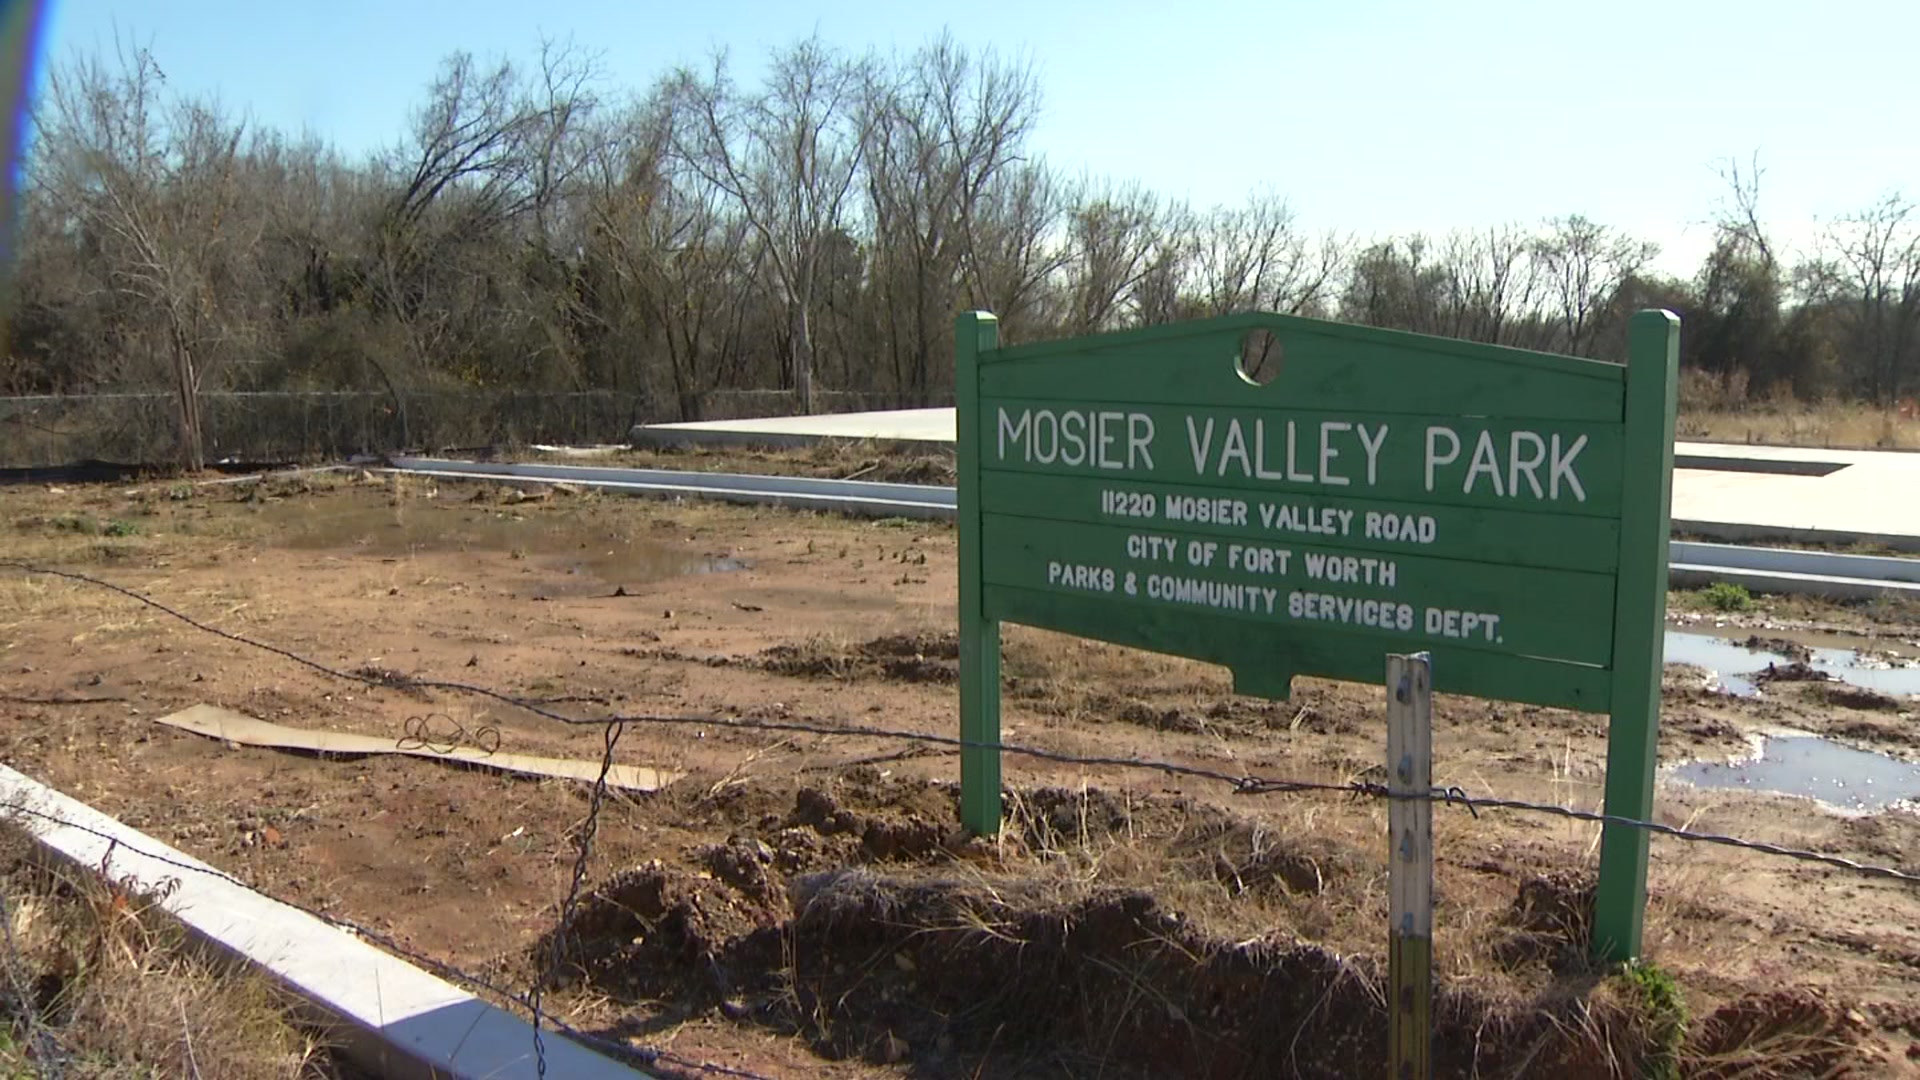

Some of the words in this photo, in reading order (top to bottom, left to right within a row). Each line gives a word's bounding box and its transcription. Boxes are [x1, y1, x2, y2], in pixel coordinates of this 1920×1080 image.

[997, 406, 1155, 470] MOSIER
[1185, 415, 1389, 486] VALLEY
[1424, 426, 1588, 502] PARK
[1101, 490, 1157, 518] 11220
[1165, 495, 1248, 526] MOSIER
[1258, 503, 1354, 536] VALLEY
[1364, 512, 1437, 544] ROAD
[1126, 535, 1178, 562] CITY
[1187, 541, 1219, 567] OF
[1228, 545, 1293, 576] FORT
[1304, 553, 1397, 587] WORTH
[1048, 562, 1116, 593] PARKS
[1123, 572, 1138, 595] &
[1147, 574, 1277, 613] COMMUNITY
[1288, 592, 1414, 631] SERVICES
[1424, 607, 1503, 643] DEPT.
